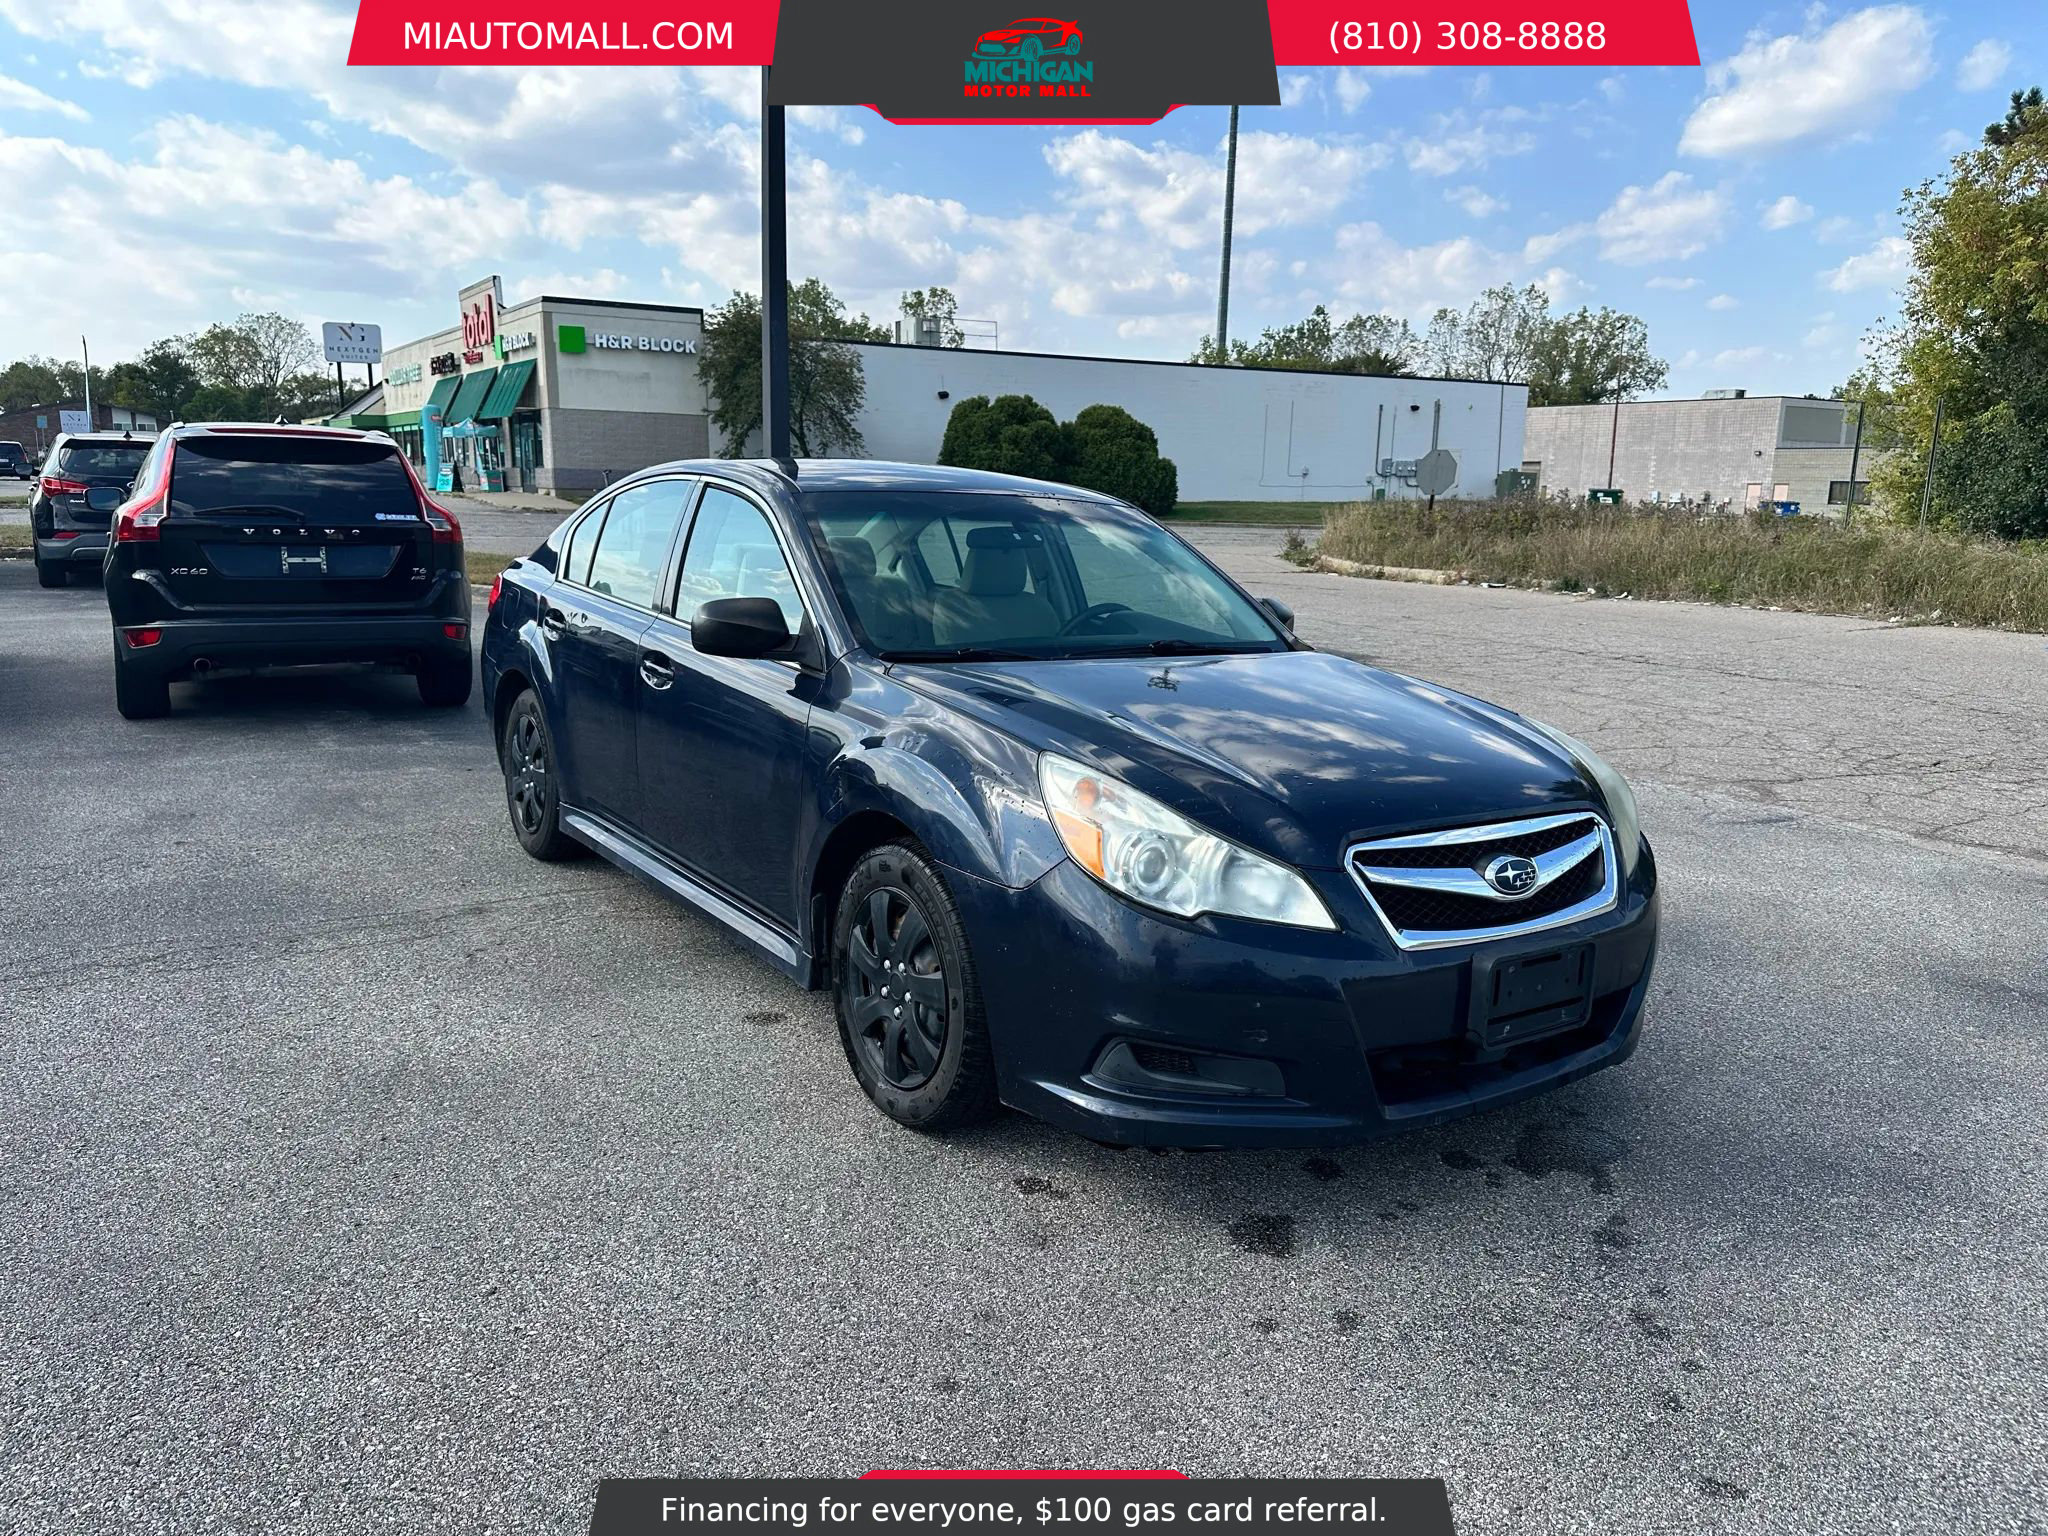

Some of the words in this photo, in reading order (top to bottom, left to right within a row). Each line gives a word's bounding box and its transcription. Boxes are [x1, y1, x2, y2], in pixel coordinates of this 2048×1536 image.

[462, 293, 494, 349] total
[594, 333, 633, 350] H&R
[638, 336, 697, 354] BLOCK
[329, 345, 378, 353] NEXTGEN
[243, 528, 361, 536] VOLVO
[170, 567, 208, 575] XC60
